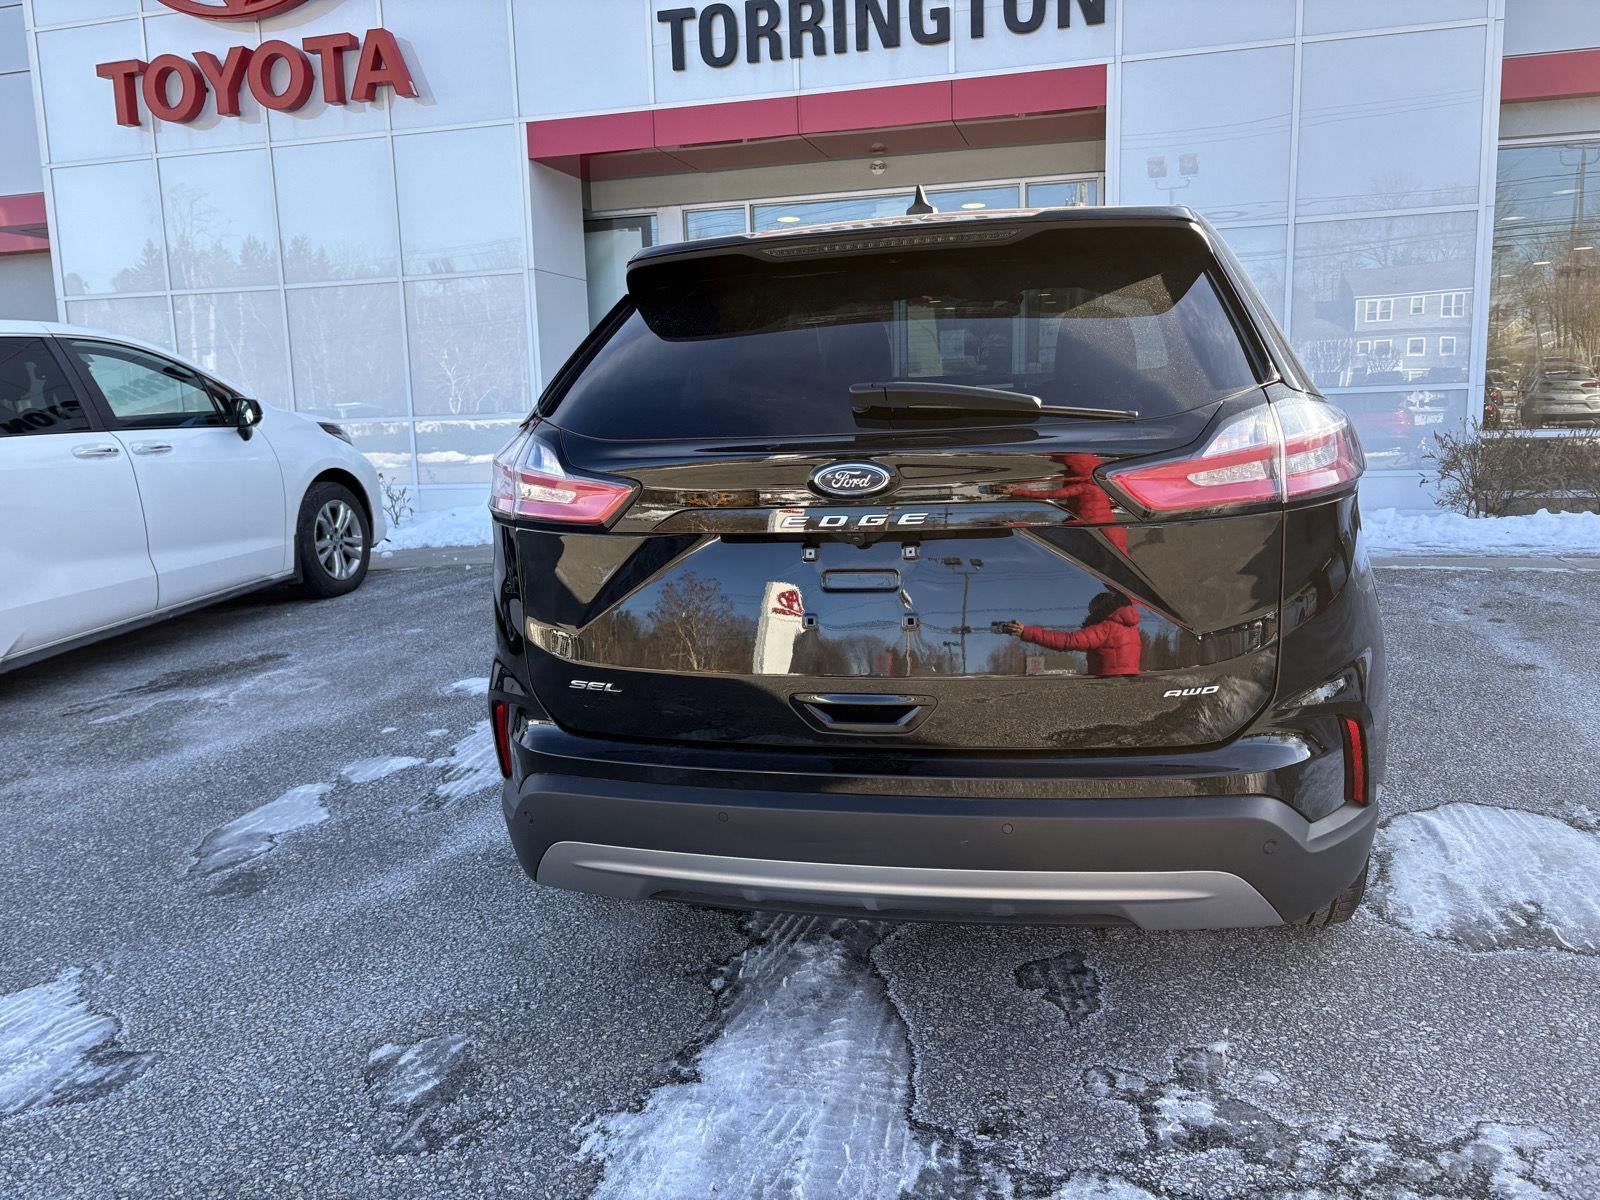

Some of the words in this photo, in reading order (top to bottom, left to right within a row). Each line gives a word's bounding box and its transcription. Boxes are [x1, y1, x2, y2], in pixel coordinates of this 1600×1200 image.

[96, 28, 419, 127] TOYOTA
[831, 470, 871, 488] Ford
[780, 512, 929, 528] EDGE
[568, 679, 623, 693] SEL
[1163, 685, 1220, 698] AWD
